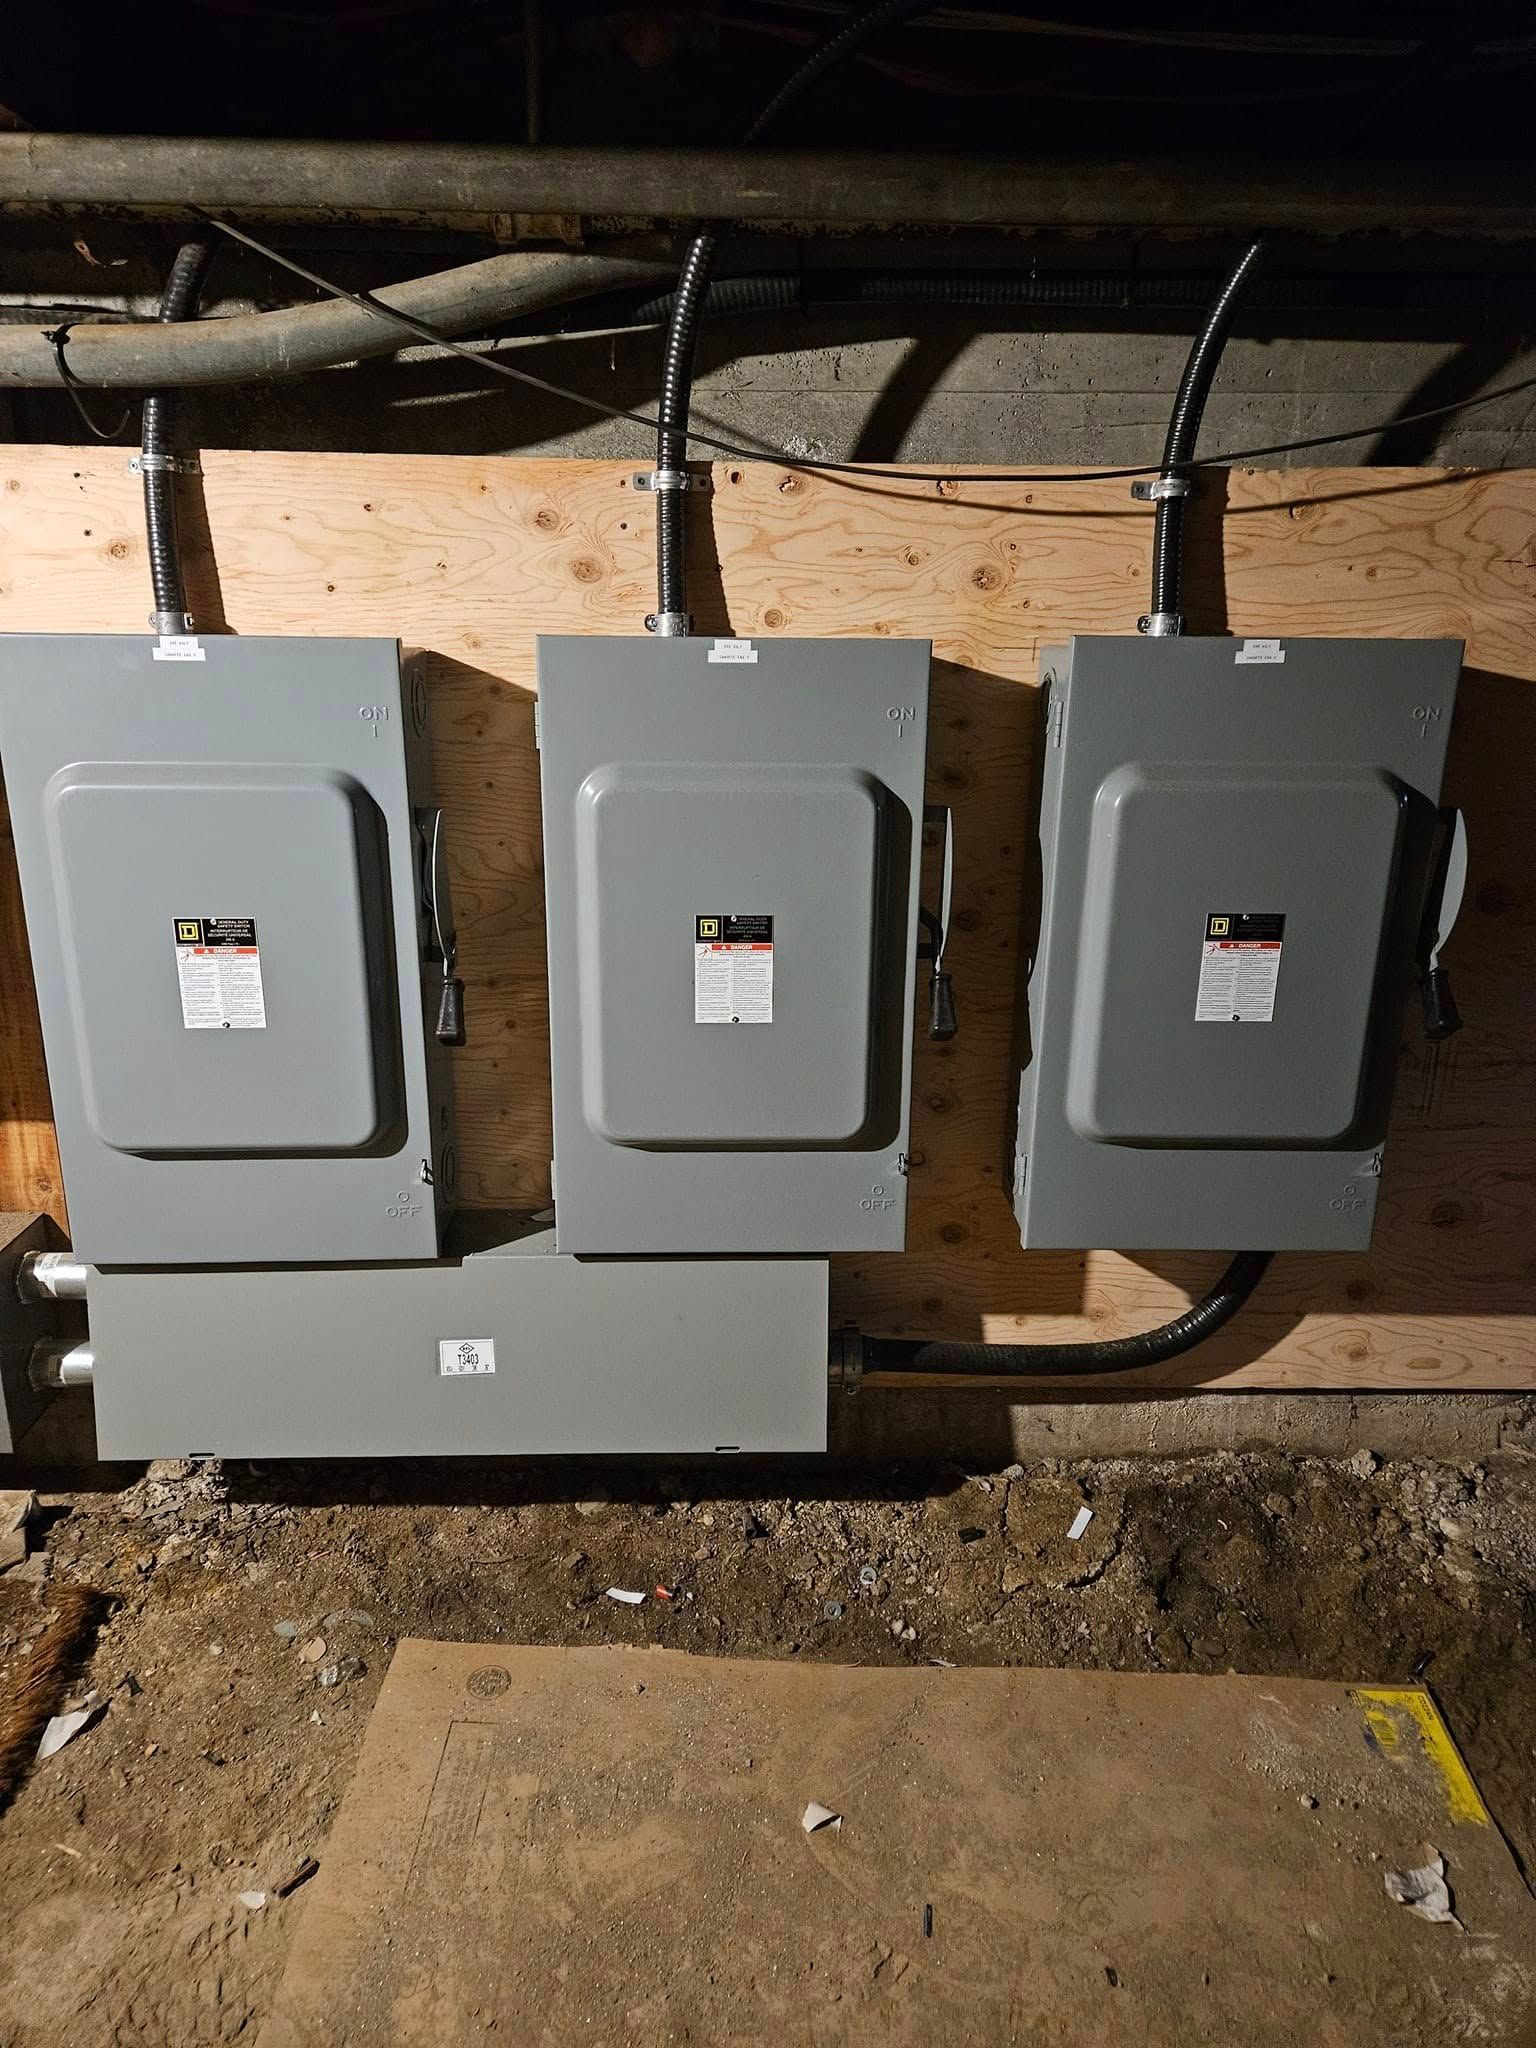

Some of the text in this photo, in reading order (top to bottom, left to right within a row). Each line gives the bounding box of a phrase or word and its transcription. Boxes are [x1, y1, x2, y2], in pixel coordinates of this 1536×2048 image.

[359, 706, 389, 721] ON
[886, 706, 915, 721] ON
[1412, 705, 1441, 721] ON
[385, 1206, 423, 1217] OFF
[859, 1199, 896, 1211] OFF
[1330, 1199, 1365, 1211] OFF
[457, 1353, 479, 1366] T3403
